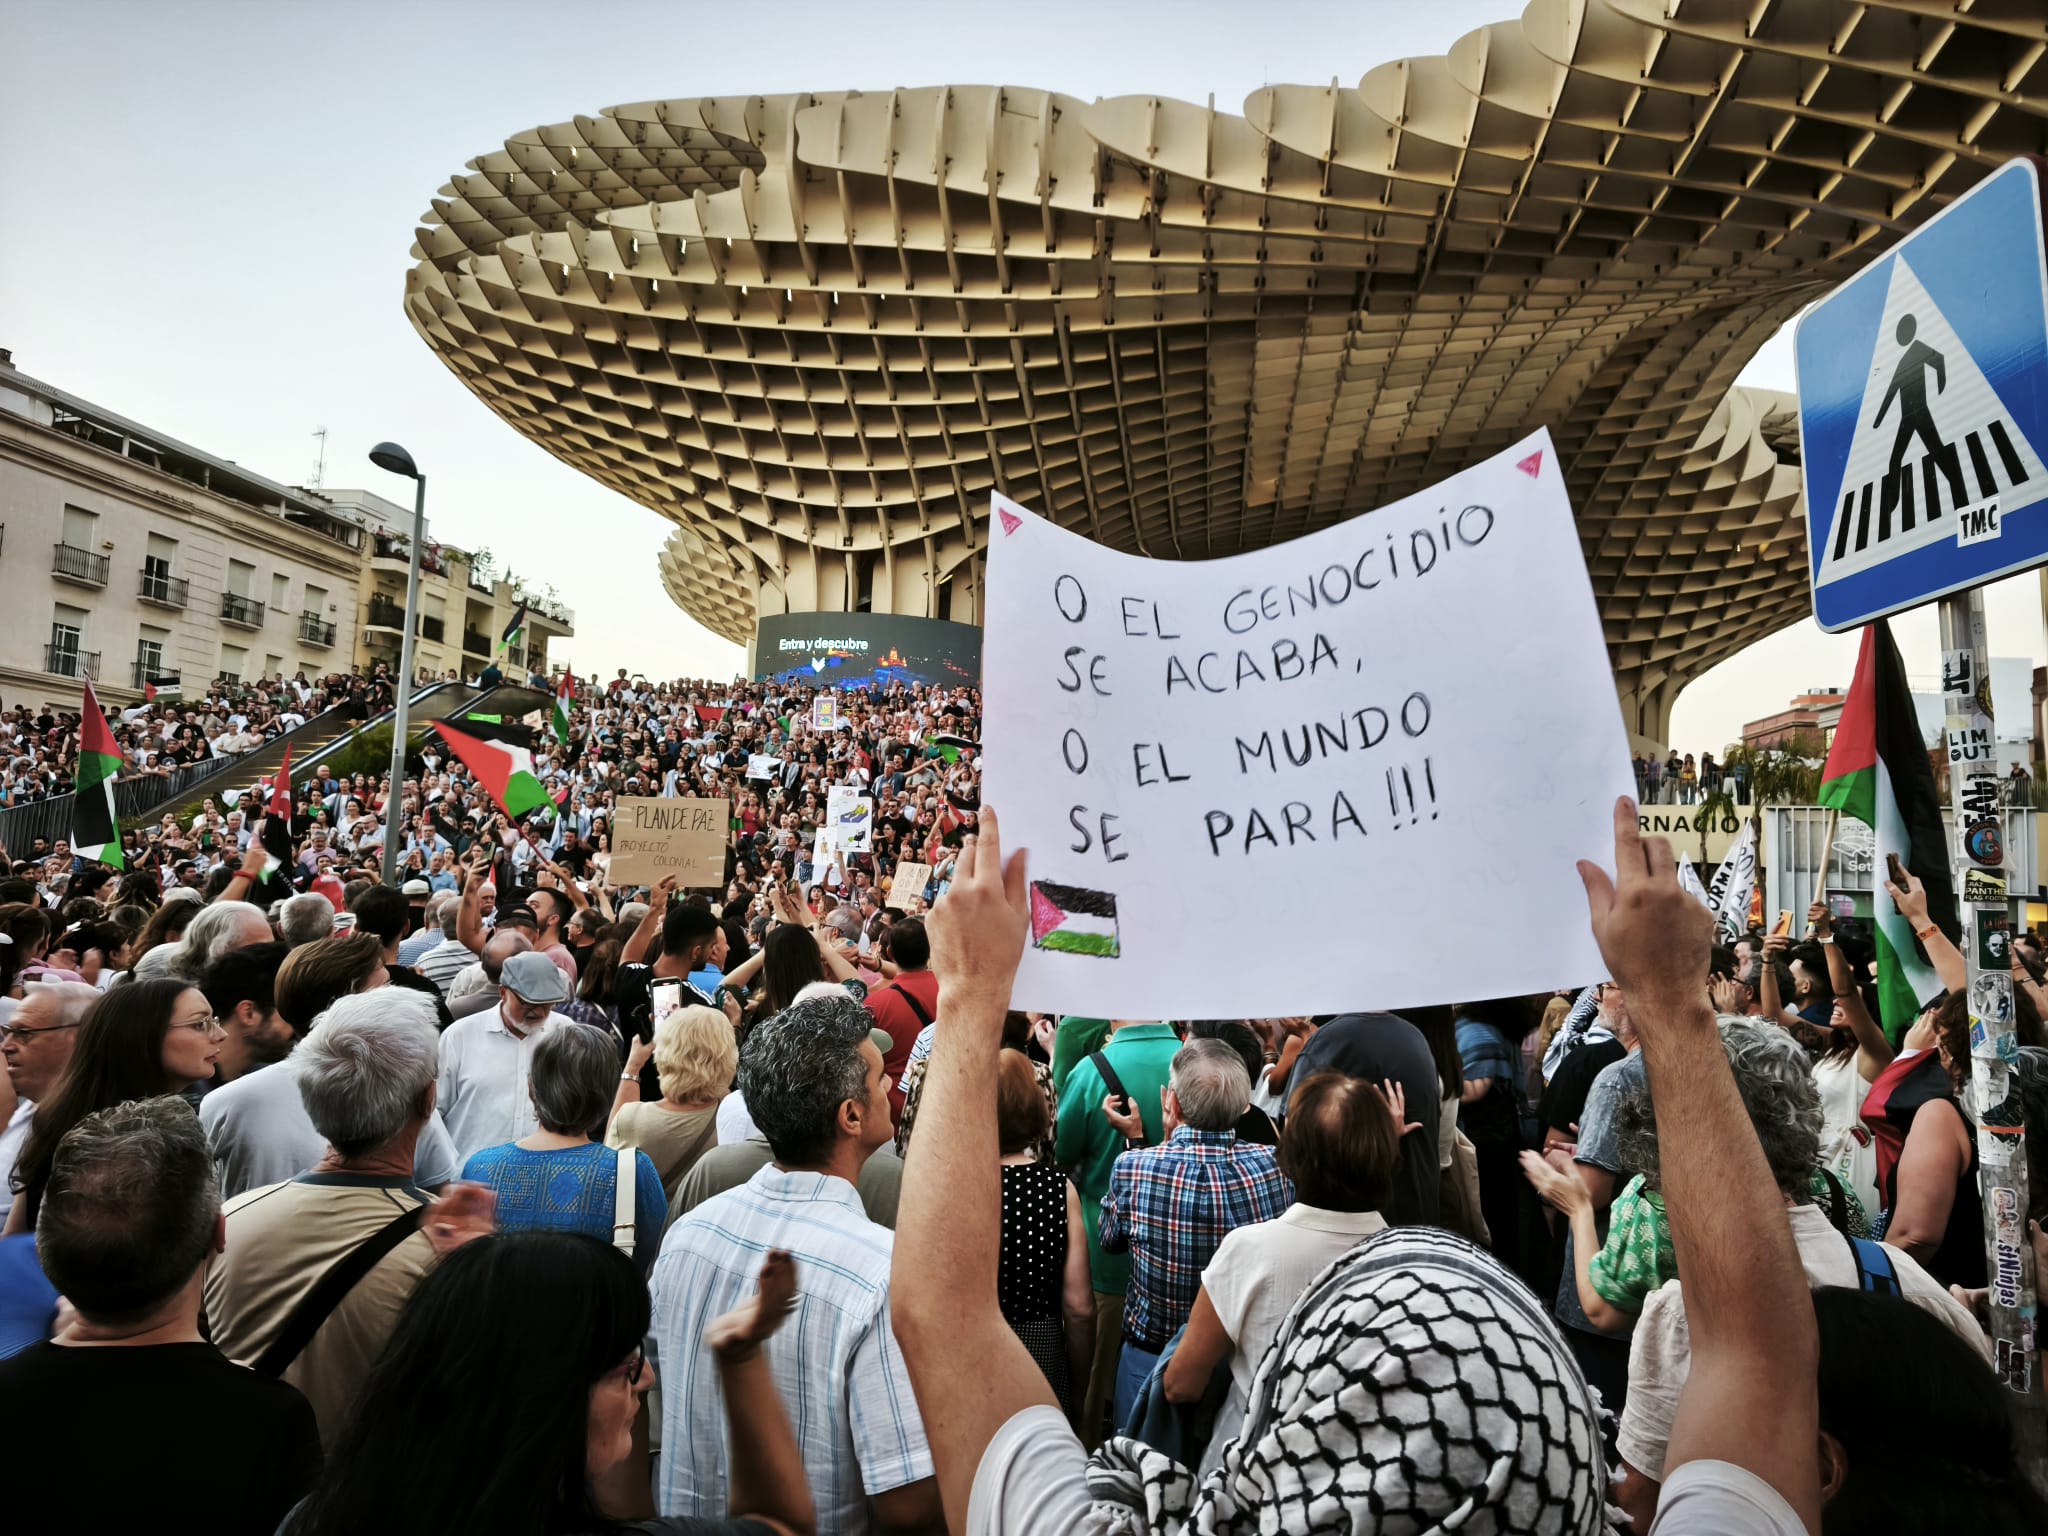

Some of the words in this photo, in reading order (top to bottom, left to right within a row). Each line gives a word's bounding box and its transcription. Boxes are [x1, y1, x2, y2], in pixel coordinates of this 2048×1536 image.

[1961, 504, 1998, 540] TMC
[1054, 574, 1088, 624] O
[1121, 597, 1181, 640] EL
[779, 638, 806, 651] Entra
[806, 640, 814, 652] y
[814, 637, 869, 651] descubre
[1056, 646, 1112, 696] SE
[1166, 633, 1363, 696] ACABA,
[1062, 727, 1089, 775] O
[1132, 742, 1192, 788] EL
[1234, 690, 1432, 775] MUNDO
[1949, 729, 1988, 746] LIM
[671, 808, 688, 830] DE
[1639, 815, 1762, 834] RNACIO
[1069, 804, 1129, 863] SE
[619, 839, 670, 853] PROYECTO
[652, 855, 699, 869] COLONIAL
[1847, 860, 1874, 872] Set
[1706, 860, 1735, 912] ORMA
[1964, 887, 2008, 896] PANTHE
